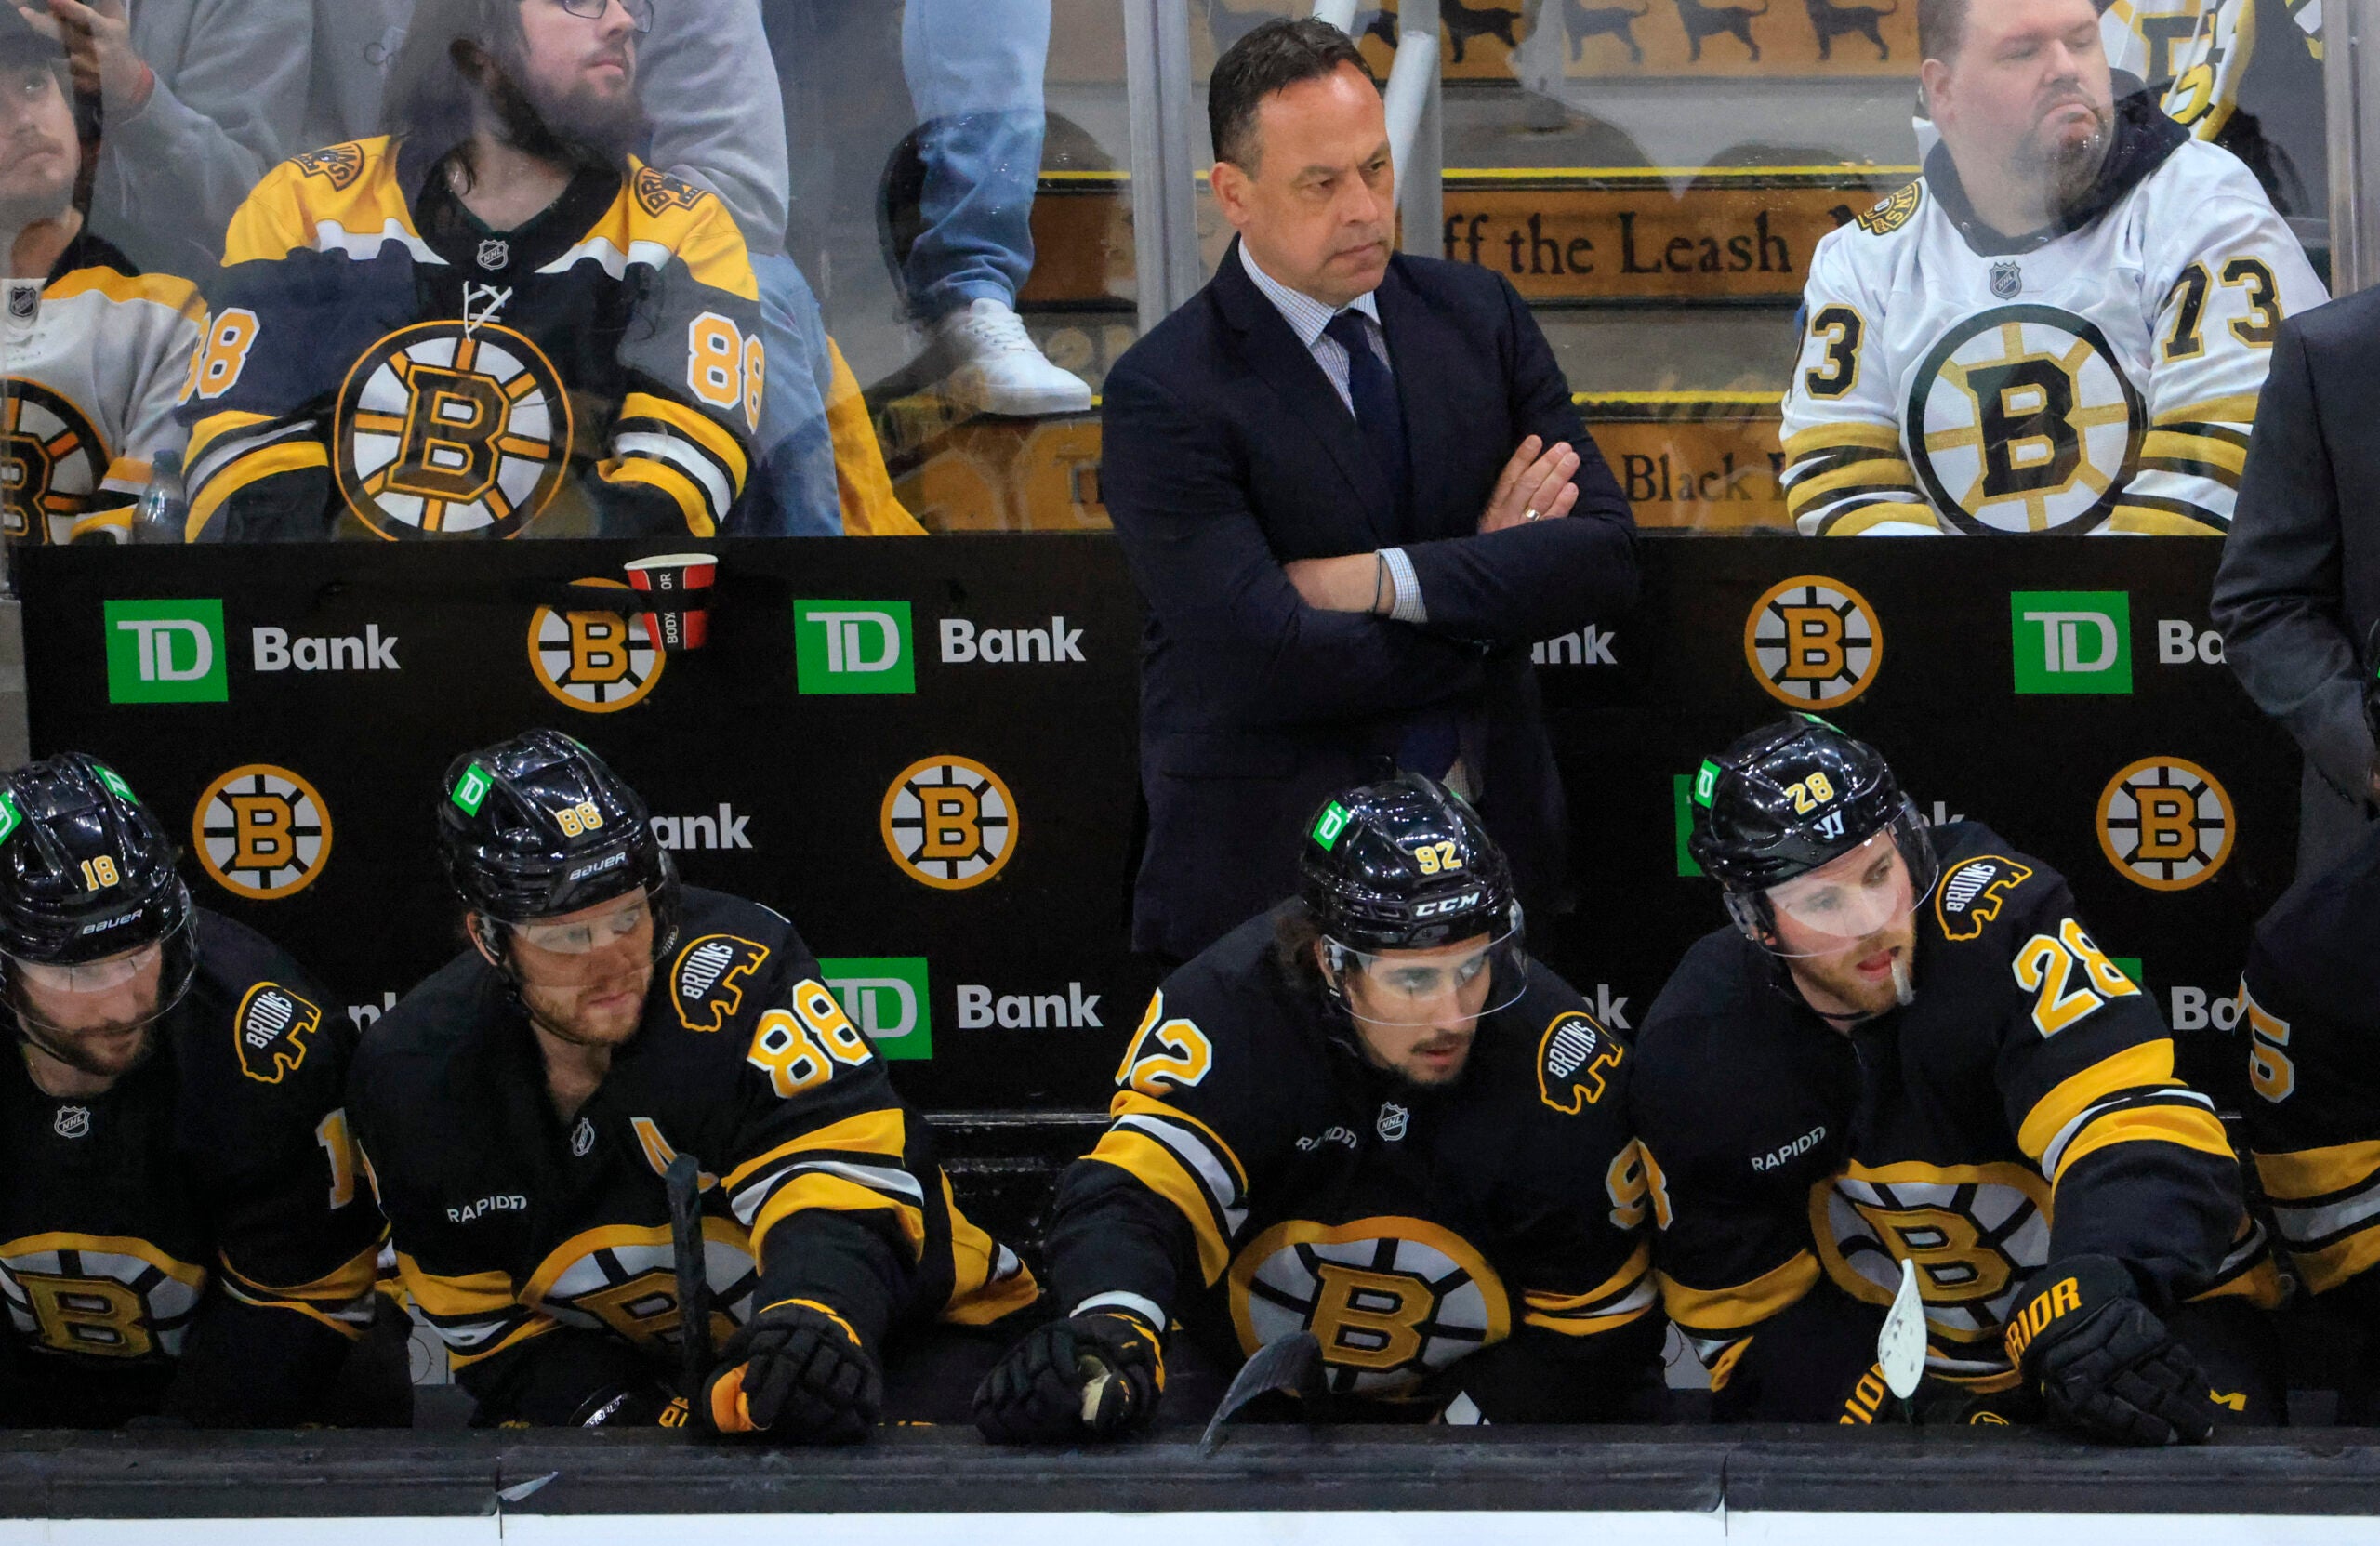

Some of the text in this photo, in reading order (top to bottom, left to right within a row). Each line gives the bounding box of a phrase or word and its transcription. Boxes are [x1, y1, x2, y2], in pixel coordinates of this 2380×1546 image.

[483, 244, 506, 265] NHL
[1443, 210, 1792, 275] ff the Leash
[2160, 255, 2284, 365] 73
[687, 311, 765, 435] 88
[1805, 302, 1867, 401] 3
[1621, 454, 1752, 502] Black
[660, 573, 672, 590] OR
[118, 619, 400, 681] TD Bank
[806, 611, 1086, 672] TD Bank
[1530, 624, 1618, 664] nk
[2023, 611, 2228, 672] TD Ba
[461, 773, 484, 805] TD
[1786, 772, 1834, 814] 28
[556, 801, 603, 838] 88
[651, 803, 753, 850] ank
[80, 854, 120, 892] 18
[1414, 840, 1462, 875] 92
[1416, 892, 1480, 917] CCM
[1946, 863, 1996, 912] BRUINS
[681, 942, 733, 999] BRUINS
[2012, 918, 2142, 1039] 28
[246, 991, 293, 1049] BRUINS
[824, 978, 1104, 1039] TD Bank
[2171, 985, 2237, 1031] Ba
[746, 979, 874, 1099] 88
[1548, 1021, 1596, 1078] BRUINS
[2234, 971, 2294, 1103] 5
[62, 1116, 84, 1130] NHL
[1295, 1126, 1357, 1151] RAID7
[1382, 1116, 1403, 1130] NHL
[315, 1107, 356, 1209] 1
[1751, 1126, 1826, 1171] RAPID7
[446, 1195, 527, 1222] RAPID7
[2005, 1276, 2082, 1368] RIOR
